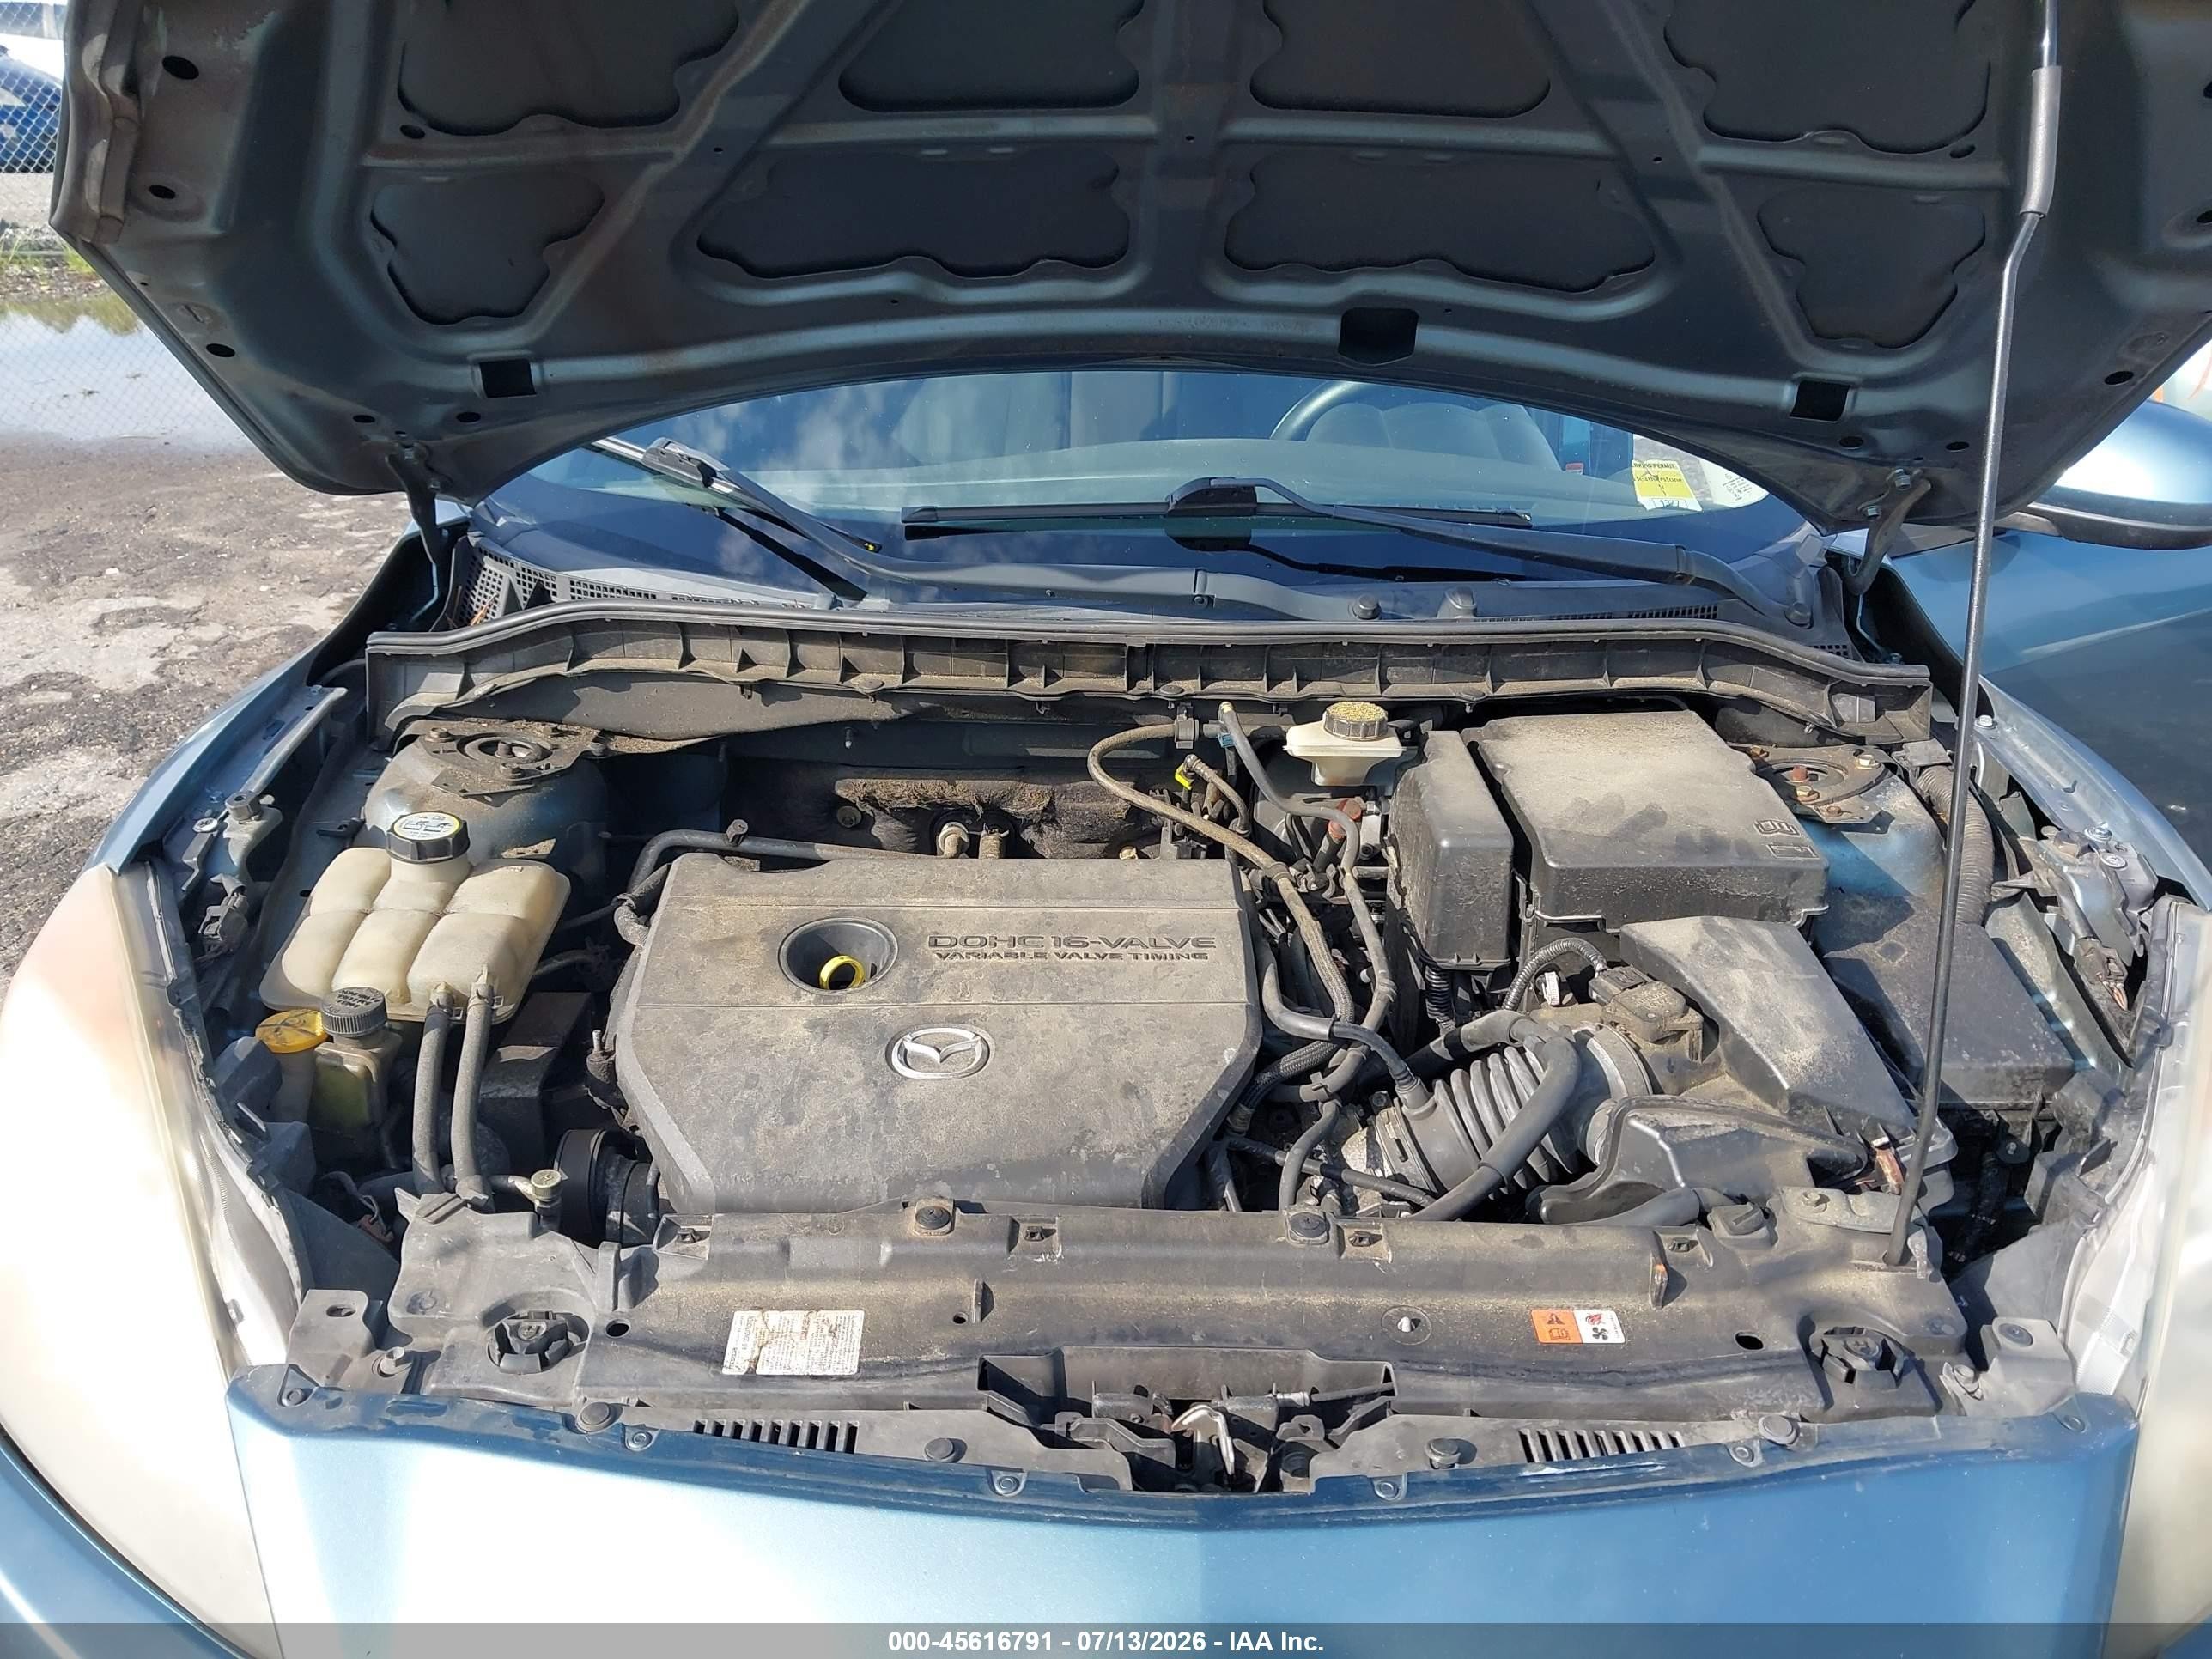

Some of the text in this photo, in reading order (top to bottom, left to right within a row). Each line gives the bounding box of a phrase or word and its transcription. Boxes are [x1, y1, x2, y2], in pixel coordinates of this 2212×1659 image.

[928, 935, 1217, 949] DOHC 16-VALVE
[934, 951, 1209, 961] VARIABLE VALVE TIMING
